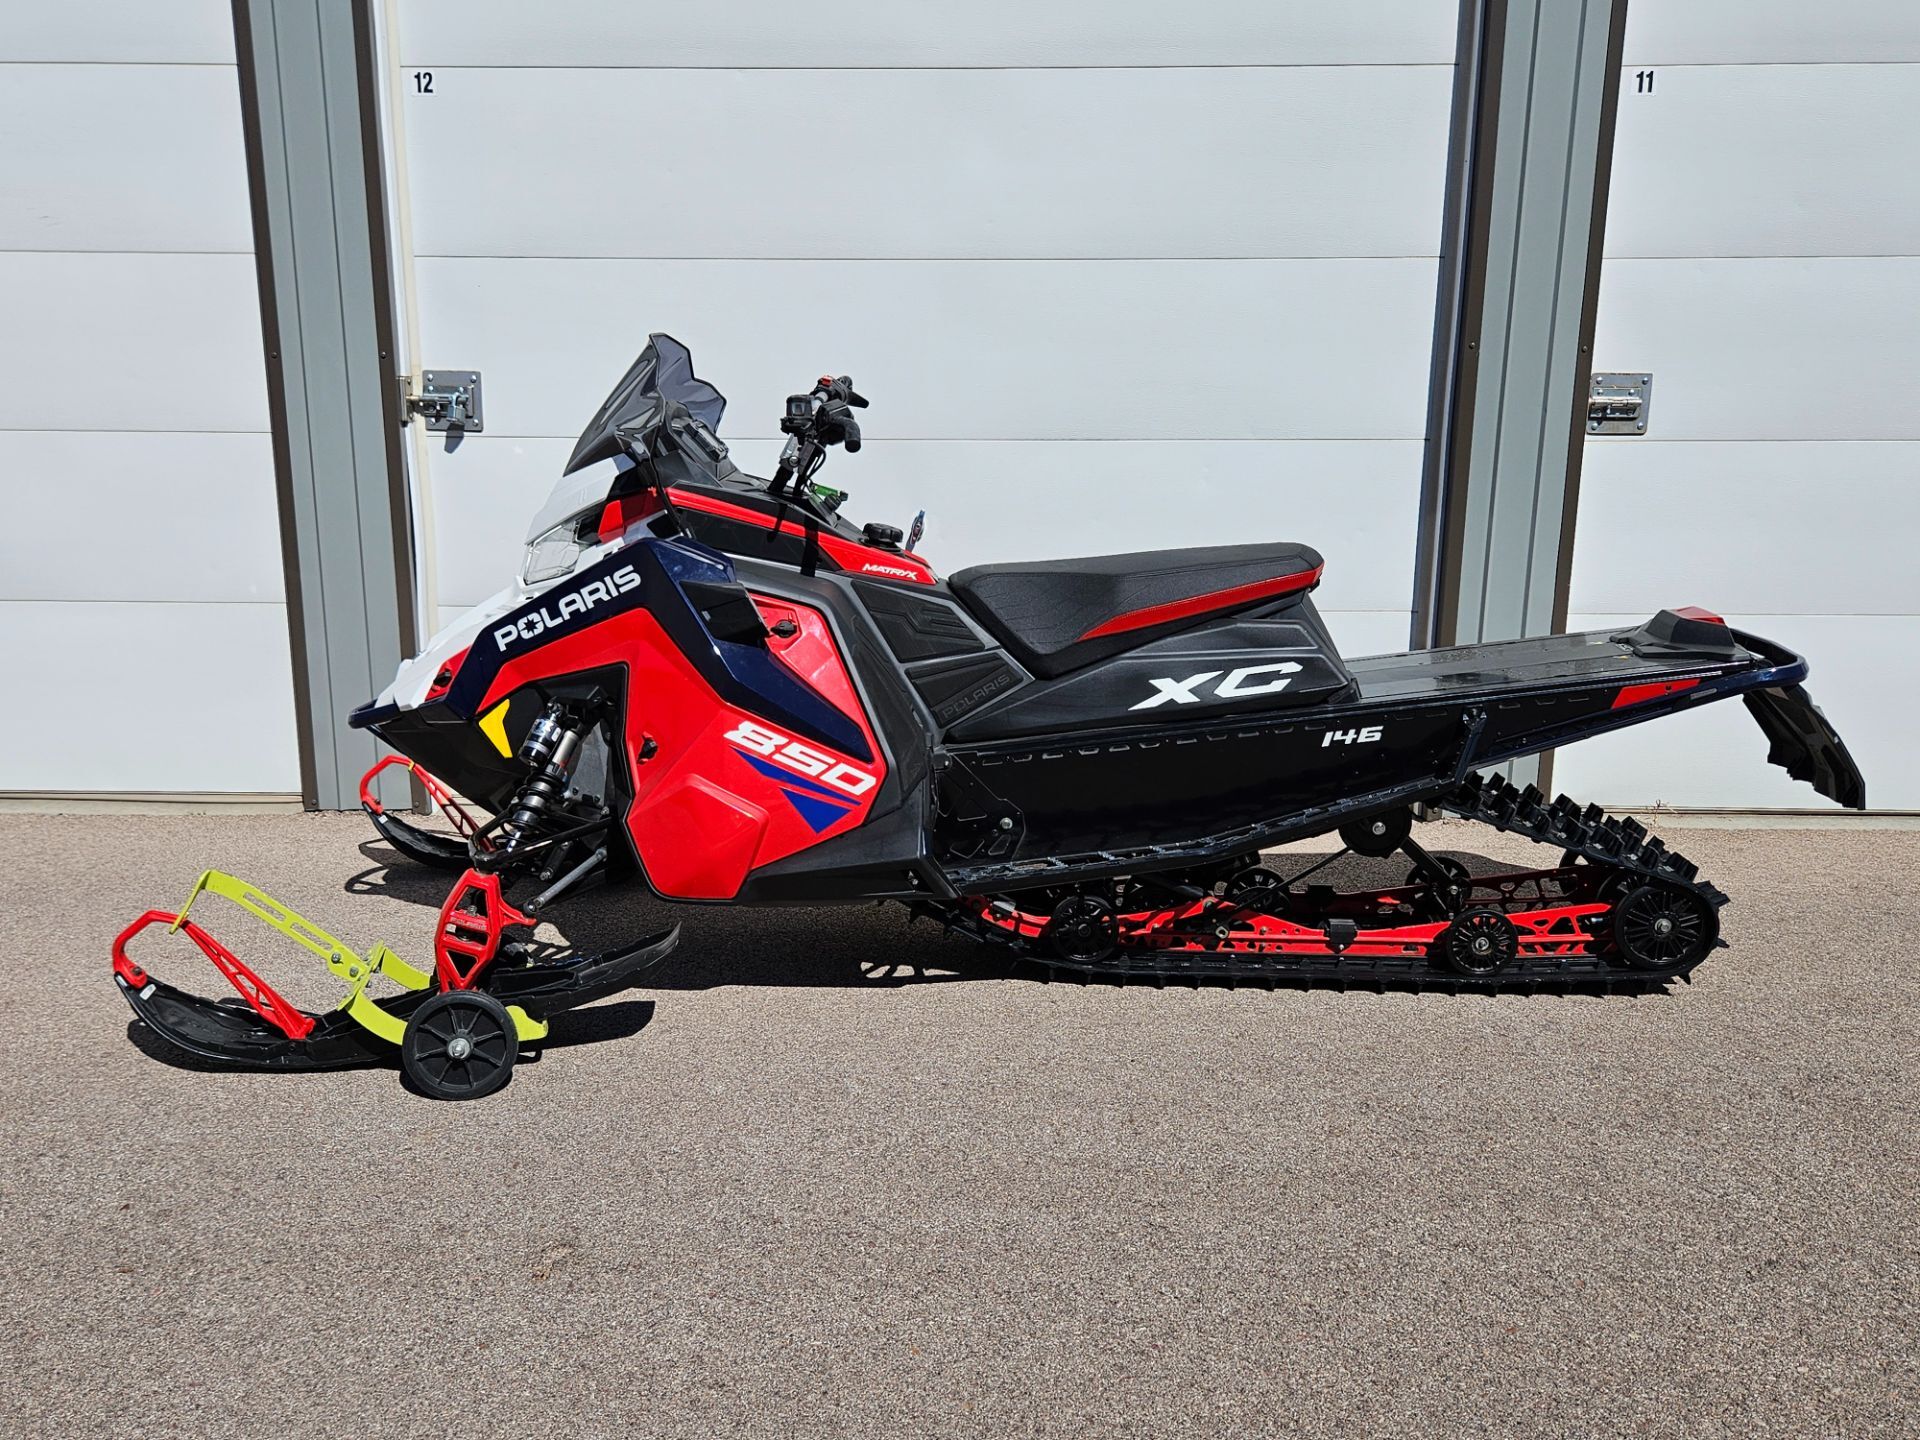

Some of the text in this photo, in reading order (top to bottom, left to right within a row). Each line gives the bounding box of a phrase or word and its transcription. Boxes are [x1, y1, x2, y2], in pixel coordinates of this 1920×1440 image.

[414, 71, 434, 93] 12
[1636, 70, 1654, 93] 11
[862, 563, 918, 581] MATRYX
[493, 564, 642, 652] POLARIS
[942, 674, 1010, 719] POLARIS
[1128, 661, 1303, 711] XC
[1321, 725, 1384, 748] 146
[723, 720, 877, 796] 850
